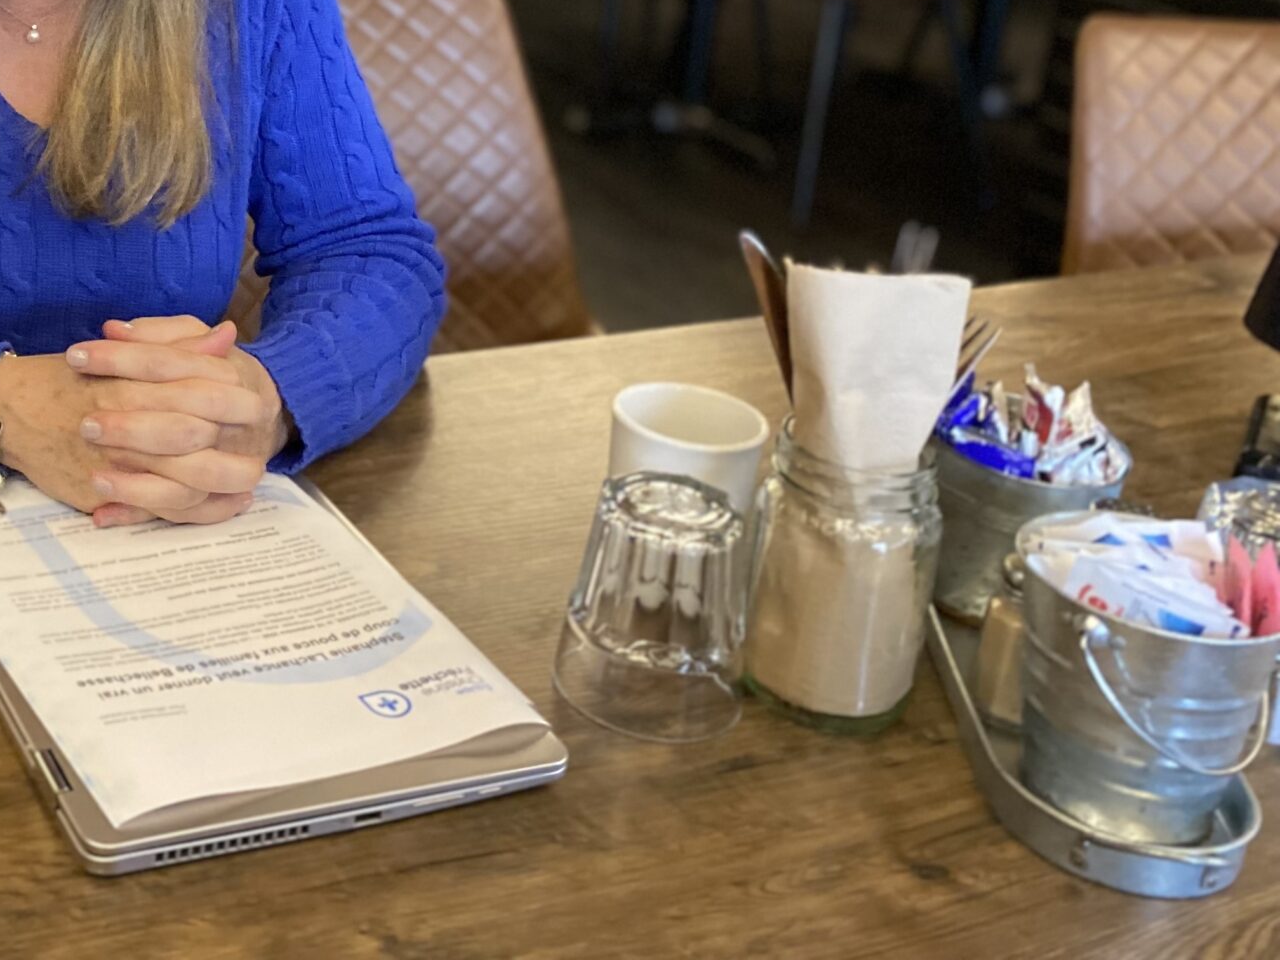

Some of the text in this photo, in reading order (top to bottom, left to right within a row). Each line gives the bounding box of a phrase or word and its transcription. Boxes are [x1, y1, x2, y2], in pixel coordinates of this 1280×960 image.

[77, 616, 400, 688] coup de pouce aux familles de Bellechasse
[98, 631, 405, 701] Stéphanie Lachance veut donner un vrai
